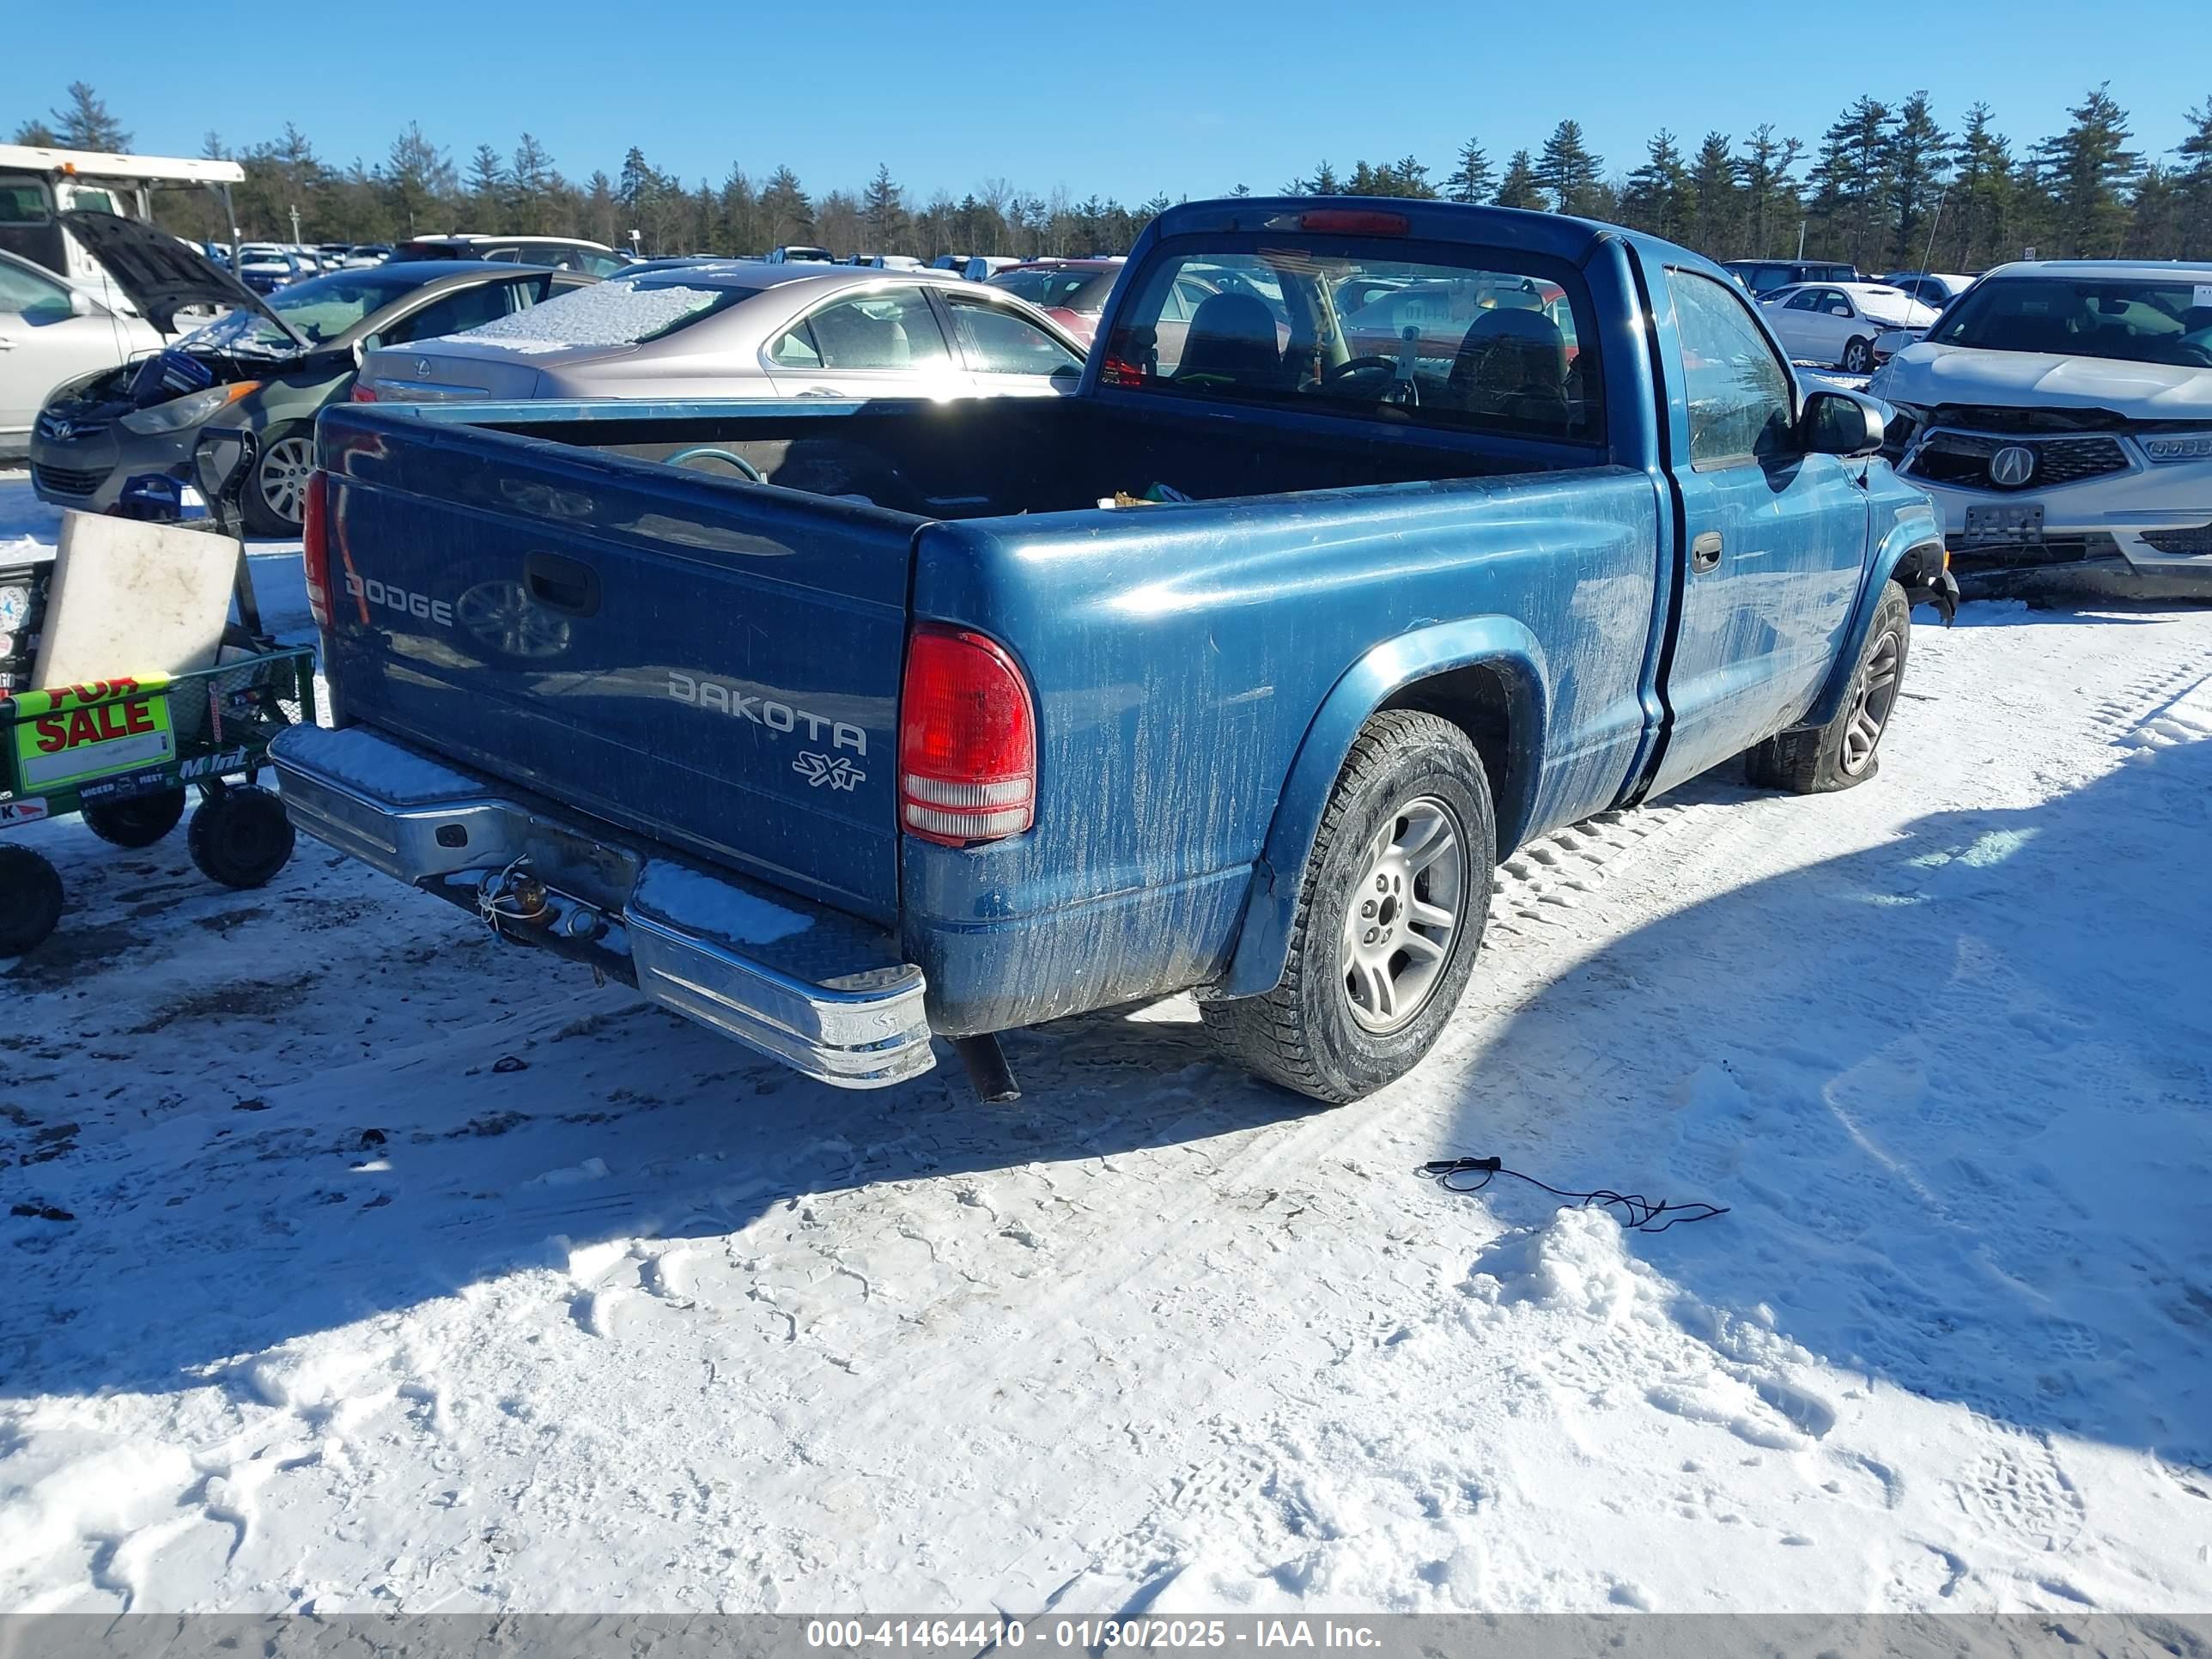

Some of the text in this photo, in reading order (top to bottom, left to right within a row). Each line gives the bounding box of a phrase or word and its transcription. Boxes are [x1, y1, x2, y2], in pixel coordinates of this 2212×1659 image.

[345, 572, 453, 627] DODGE
[36, 696, 155, 752] SALE
[668, 672, 866, 756] DAKOTA
[792, 750, 866, 792] SXT
